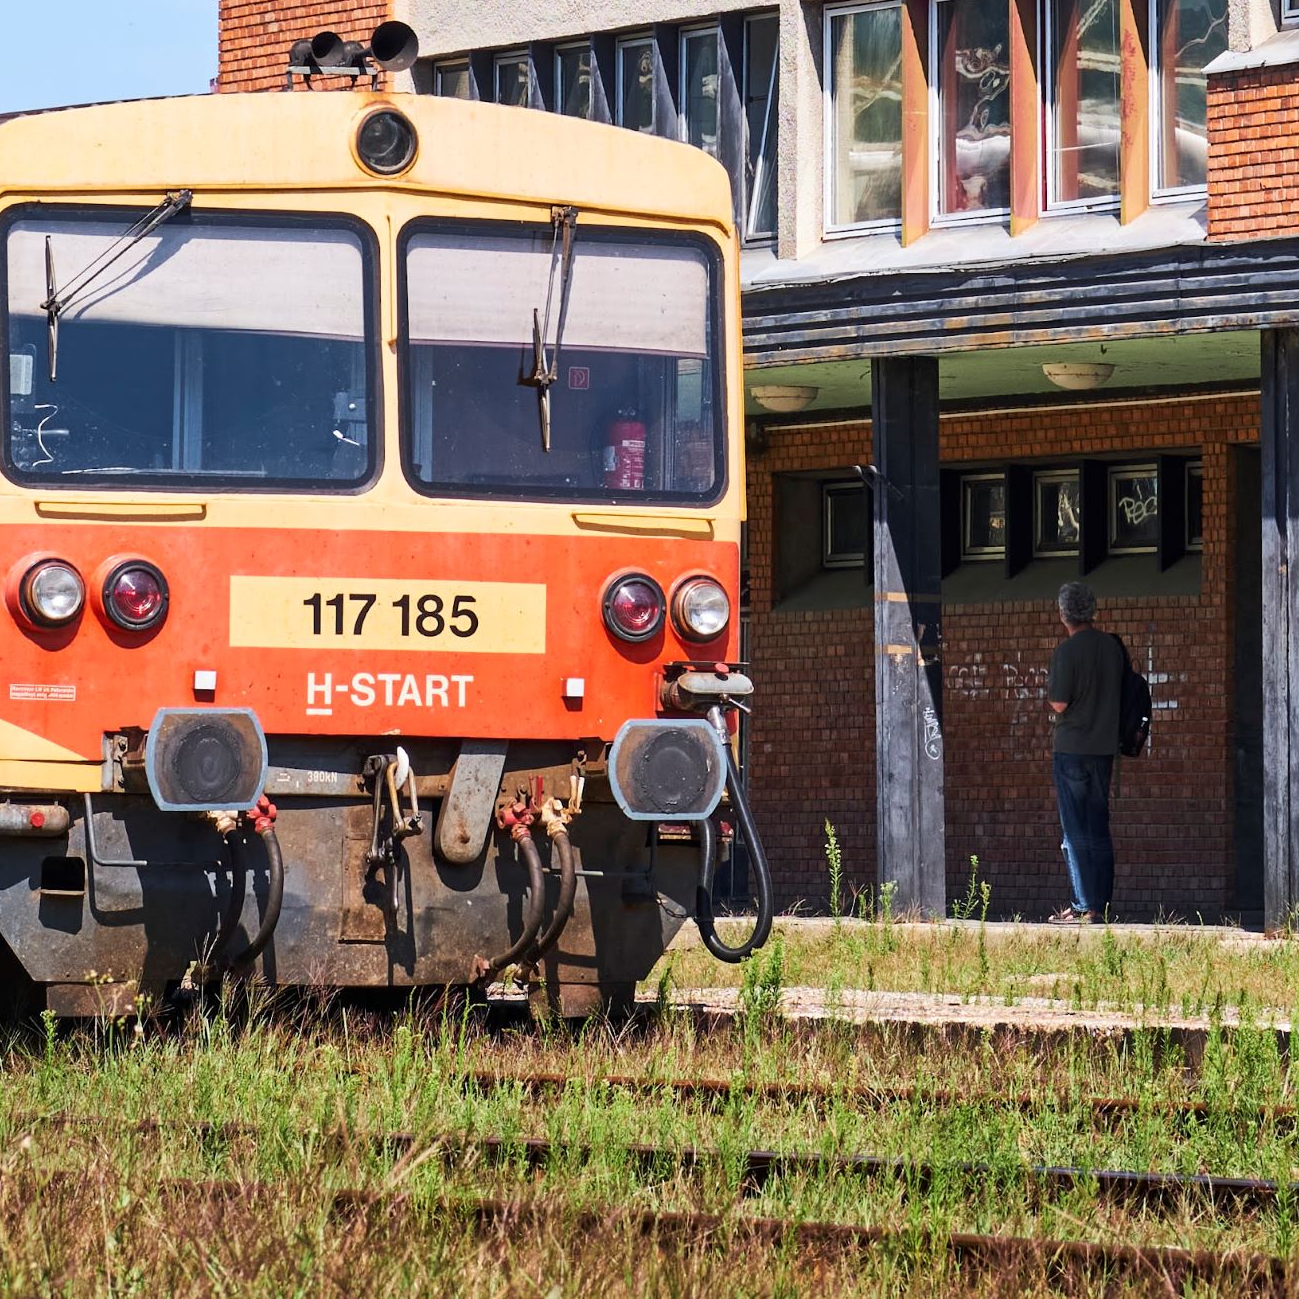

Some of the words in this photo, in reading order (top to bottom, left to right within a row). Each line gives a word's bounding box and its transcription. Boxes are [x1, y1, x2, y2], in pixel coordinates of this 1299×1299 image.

[303, 593, 377, 635] 117
[392, 594, 479, 638] 185
[306, 673, 474, 711] H-START
